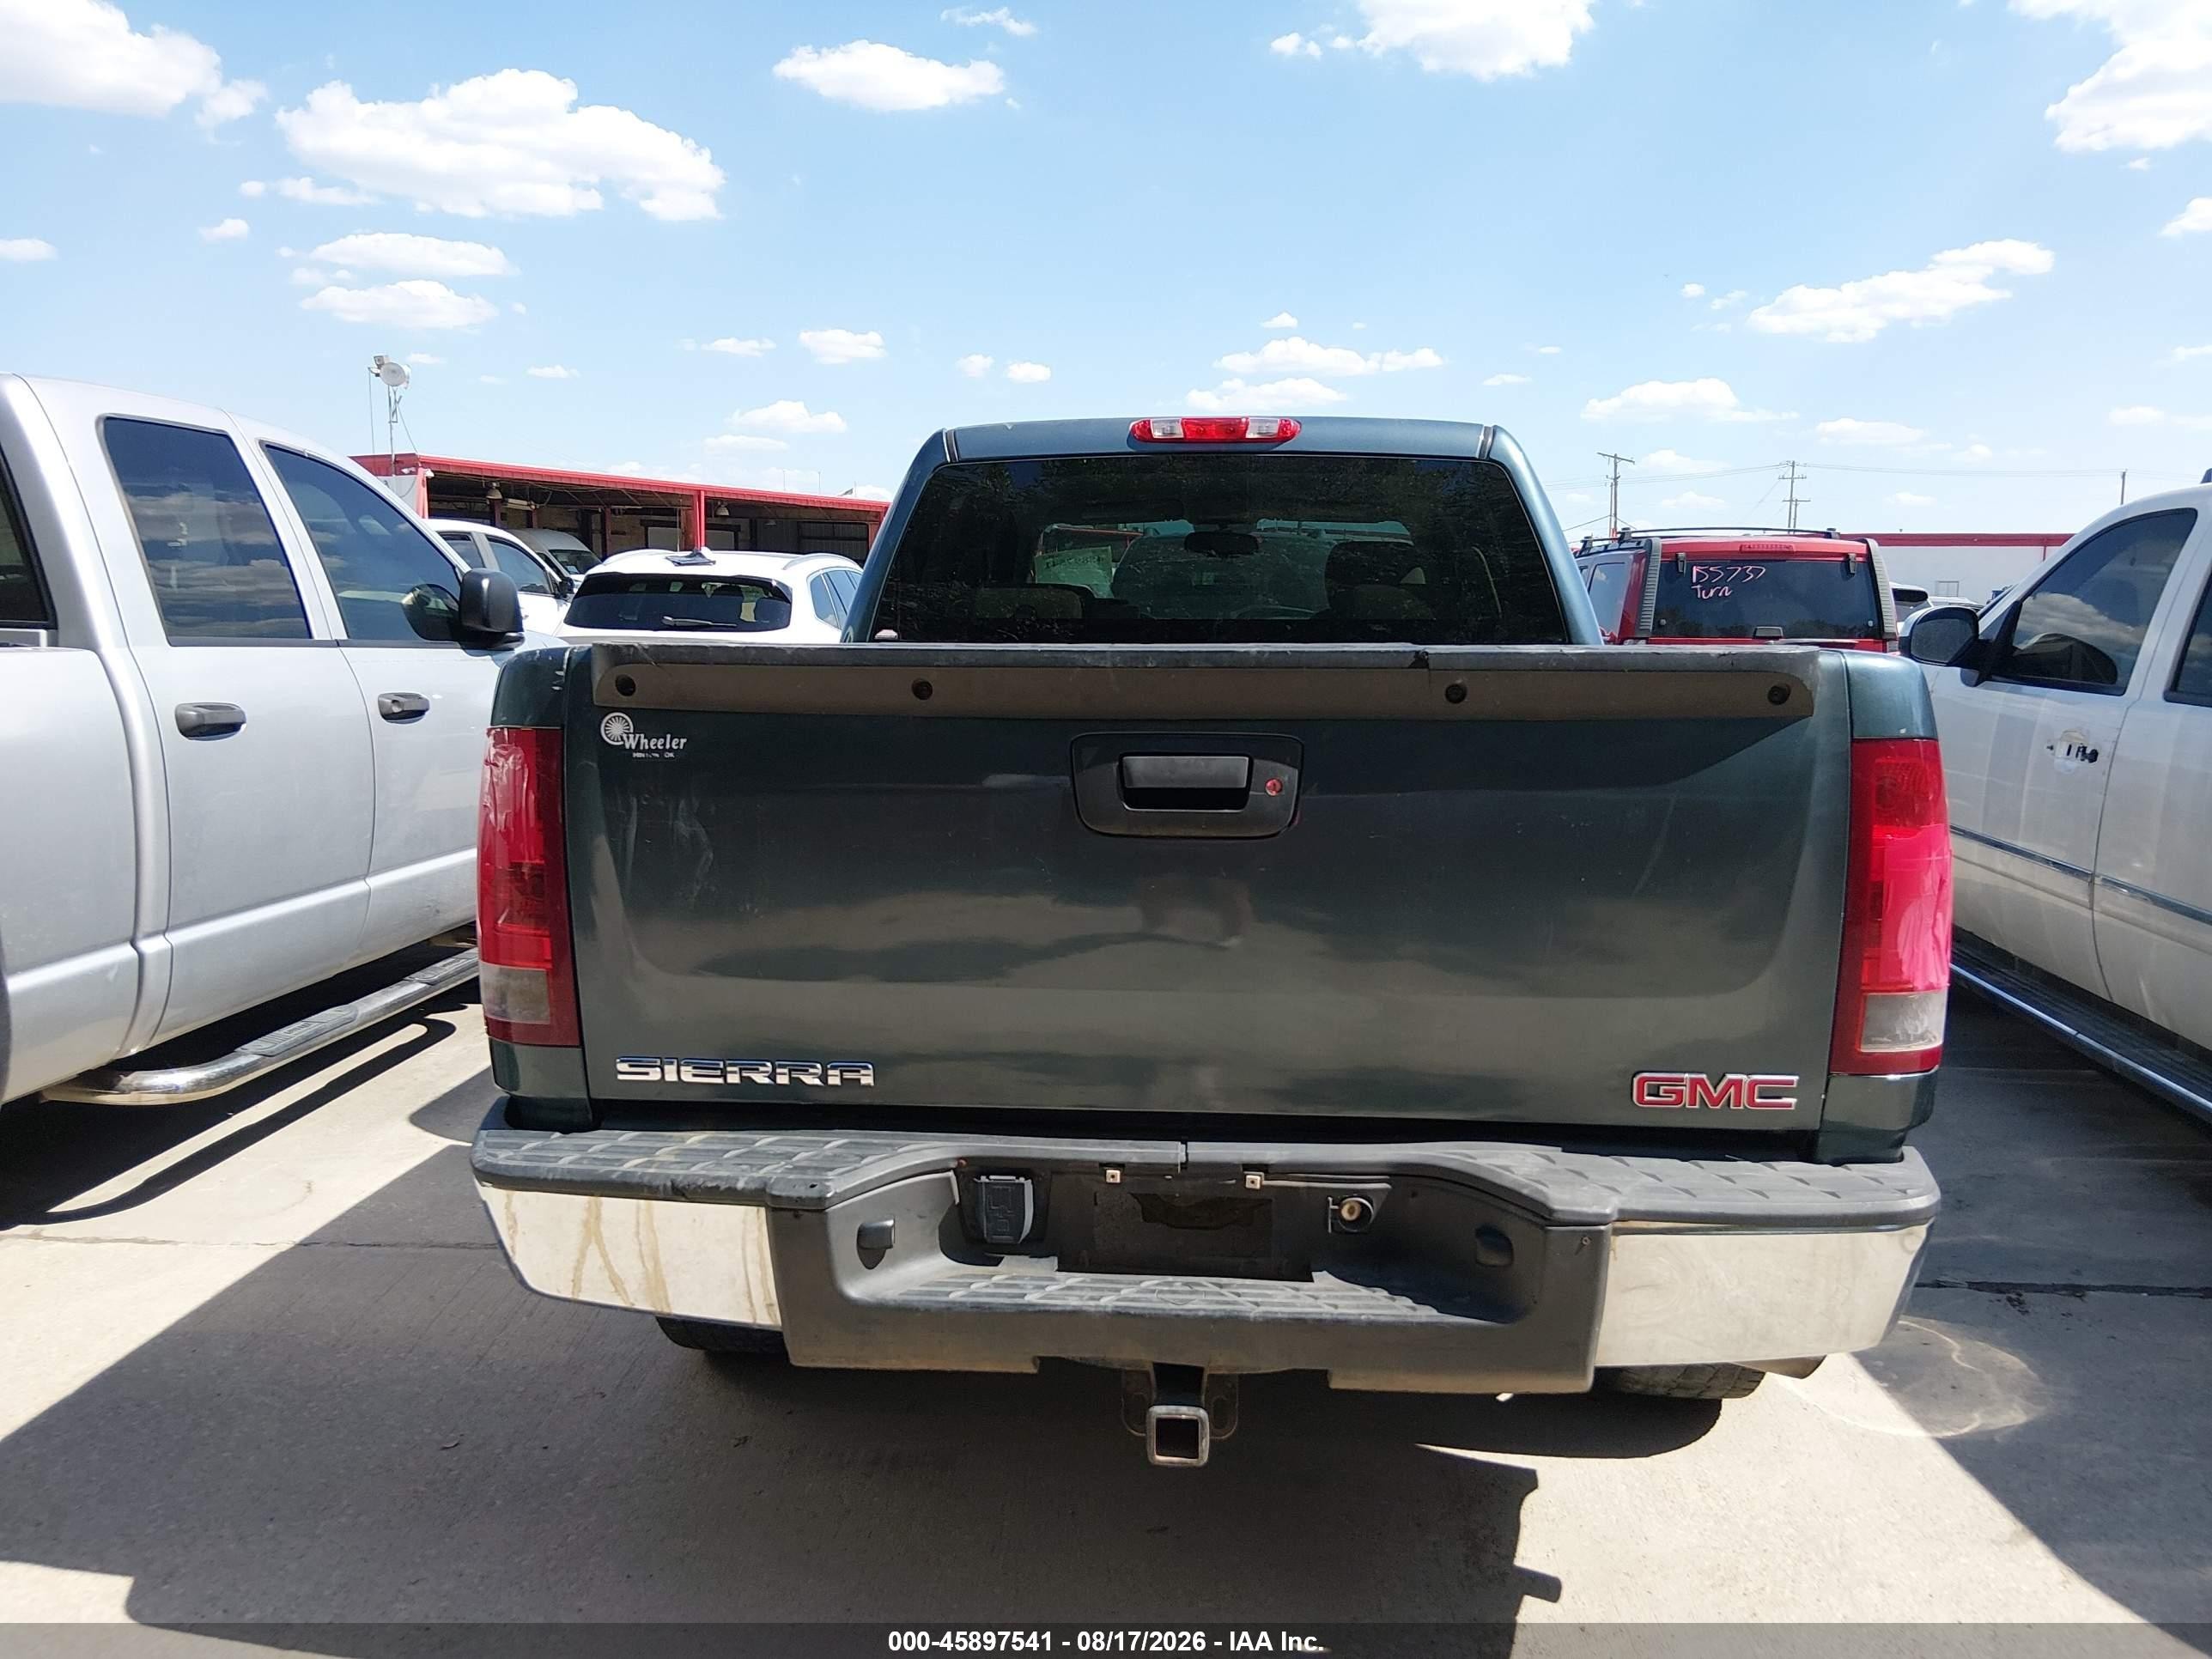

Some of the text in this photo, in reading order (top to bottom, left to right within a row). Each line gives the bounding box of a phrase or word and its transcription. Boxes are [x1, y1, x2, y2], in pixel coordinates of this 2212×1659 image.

[621, 733, 688, 750] Wheeler
[615, 1056, 875, 1087] SIERRA
[1632, 1072, 1800, 1110] GMC
